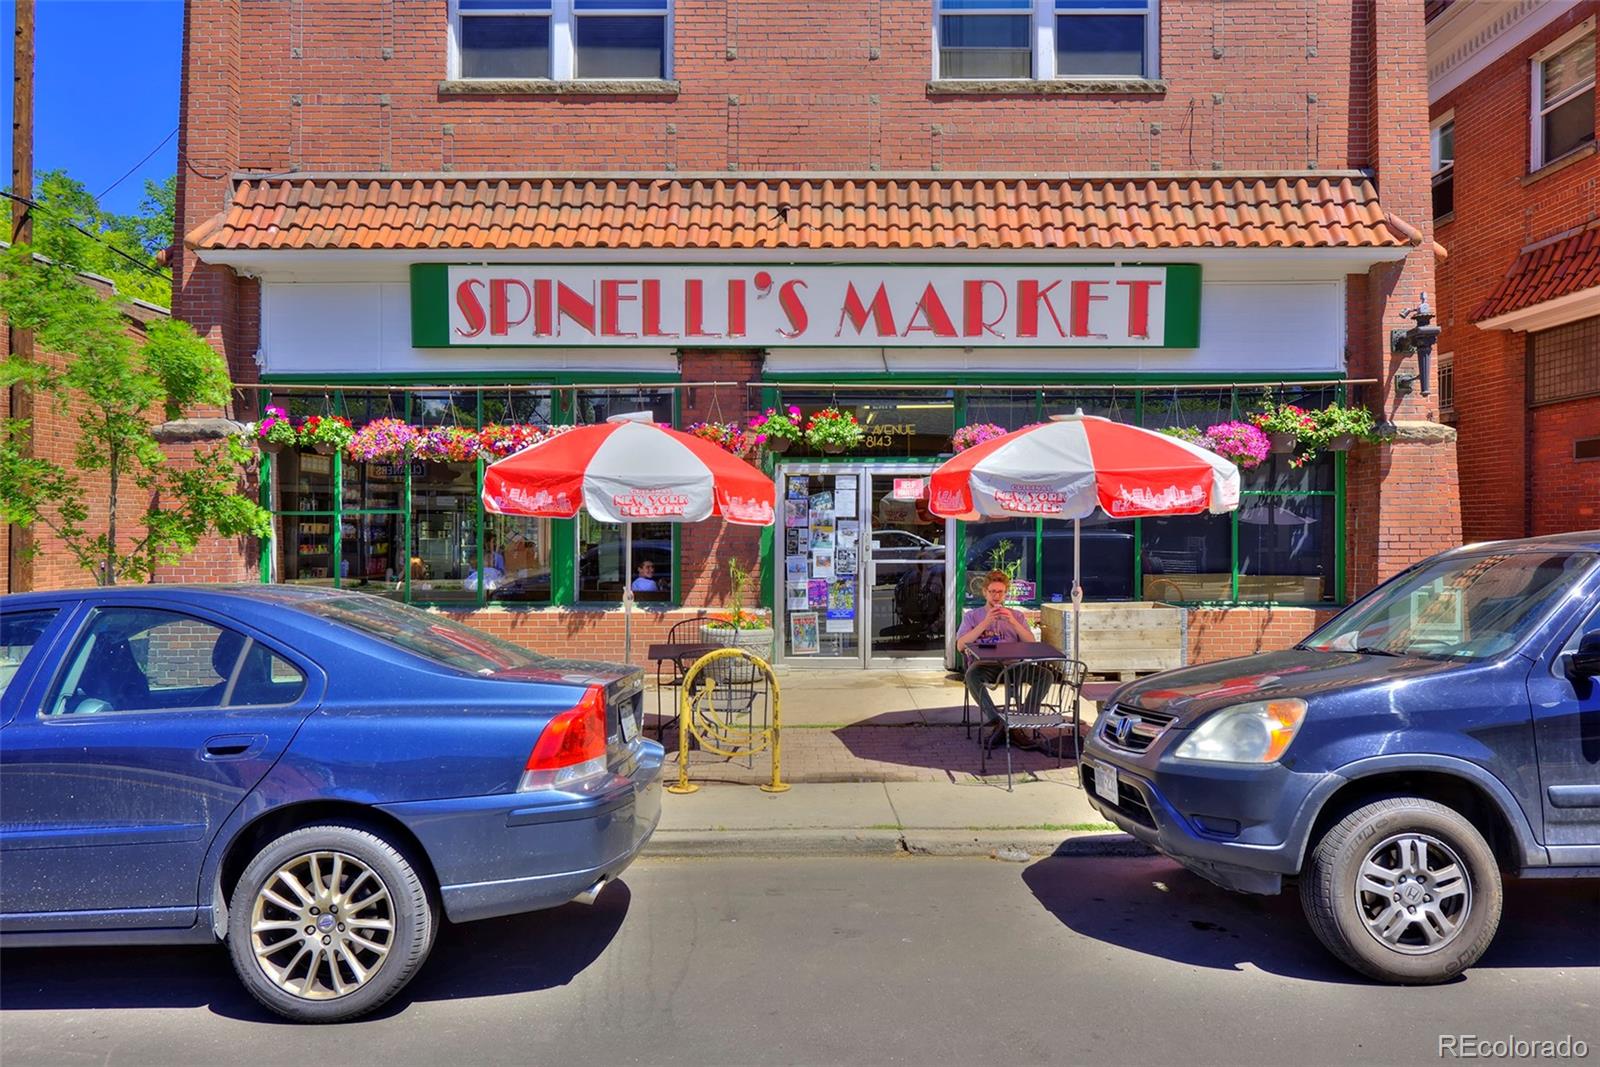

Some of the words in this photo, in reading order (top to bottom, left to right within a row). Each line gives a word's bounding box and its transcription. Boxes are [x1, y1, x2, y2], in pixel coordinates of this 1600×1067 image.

[454, 271, 809, 338] SPINELLI'S
[834, 279, 1162, 340] MARKET
[871, 424, 916, 435] AVENUE
